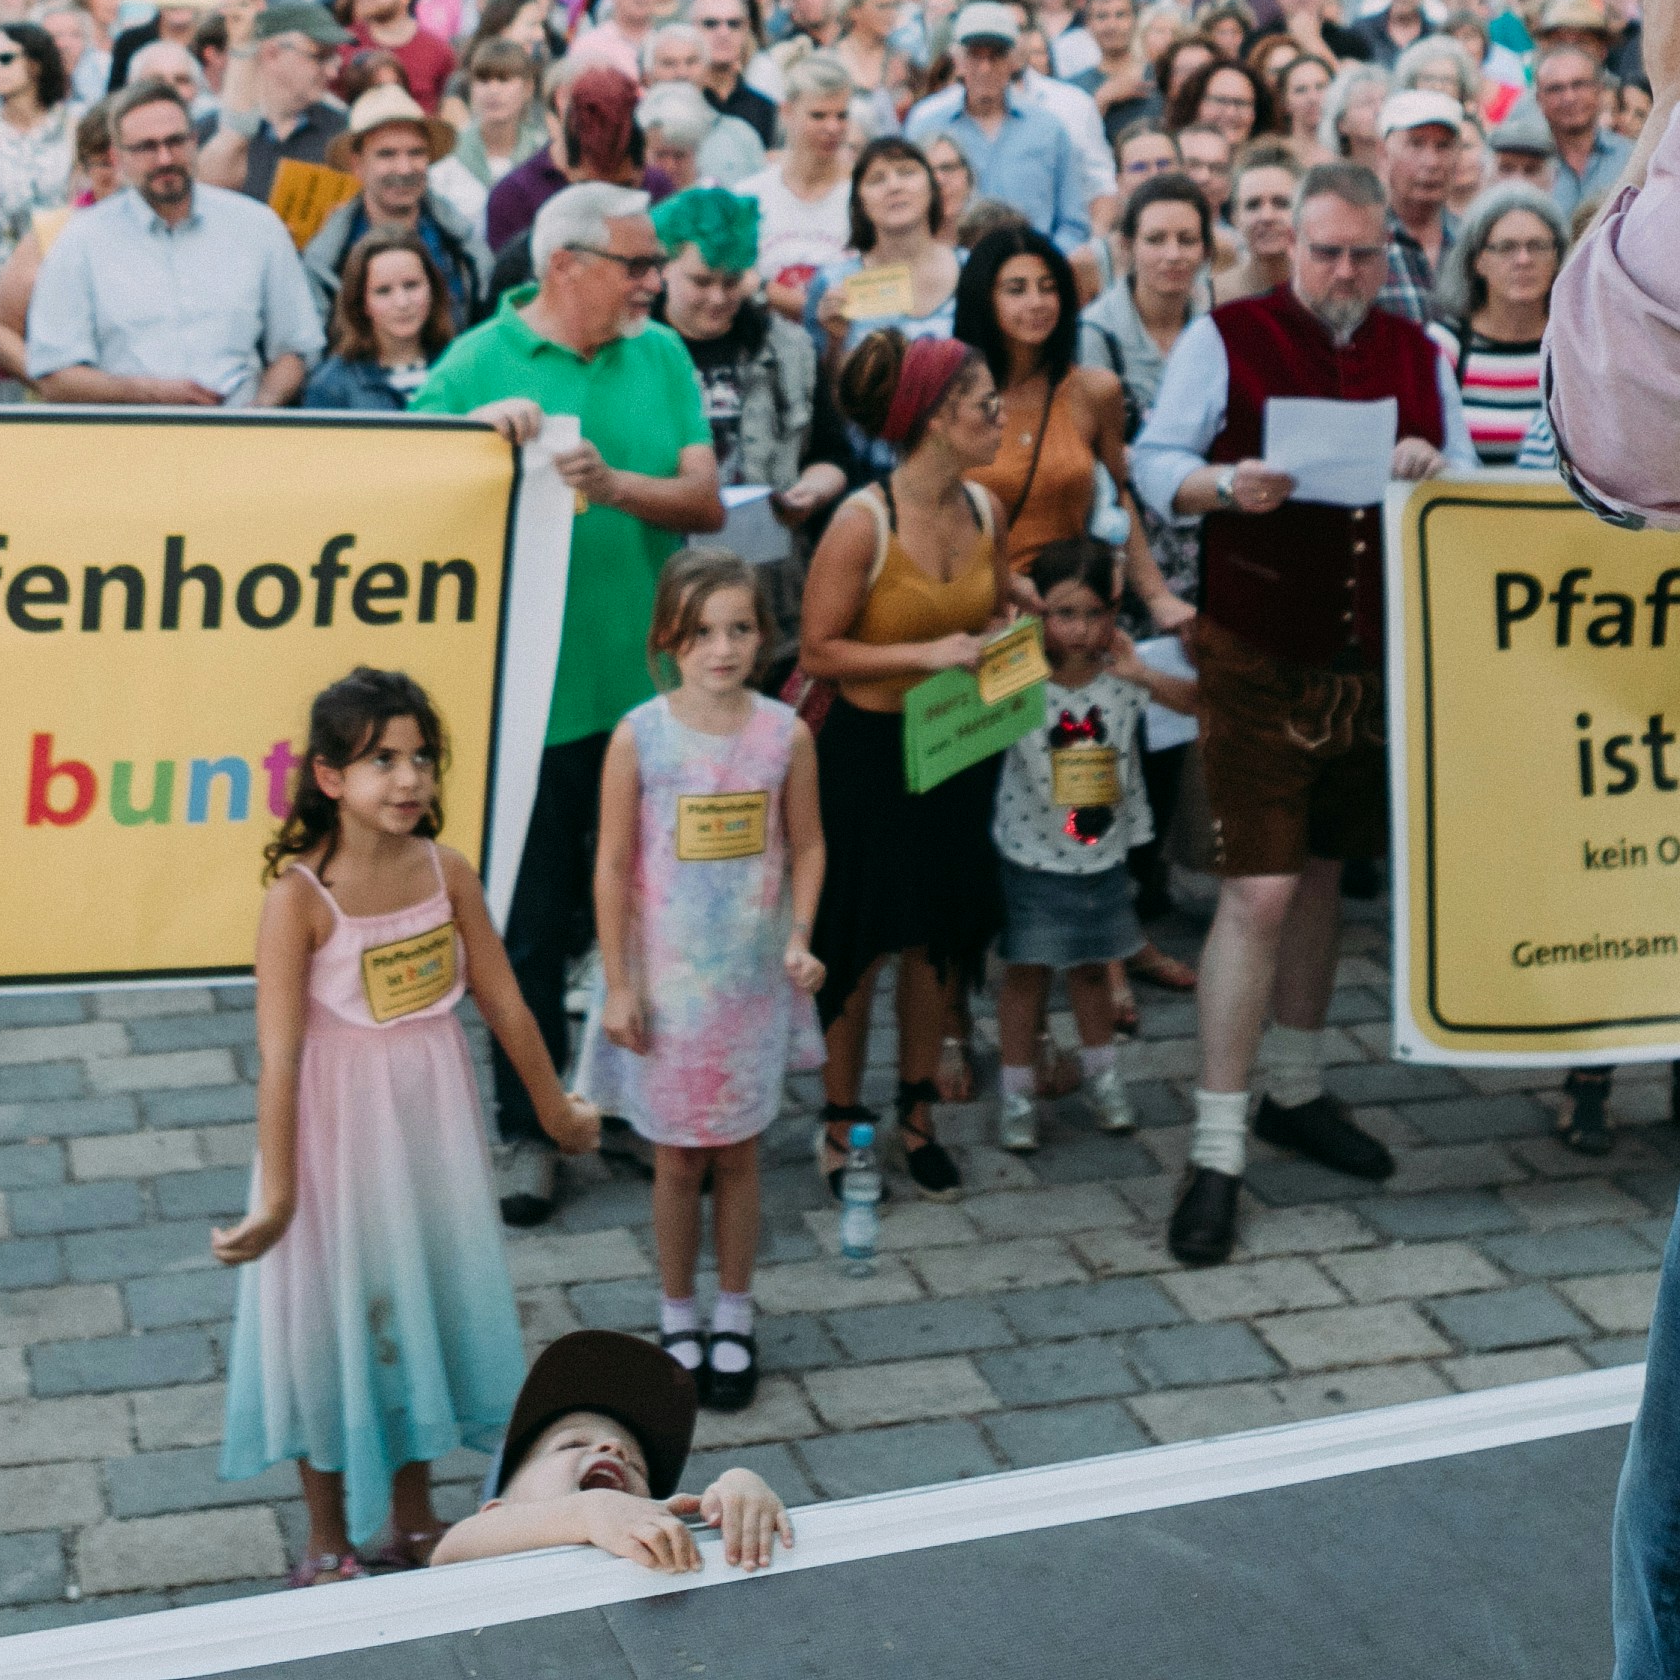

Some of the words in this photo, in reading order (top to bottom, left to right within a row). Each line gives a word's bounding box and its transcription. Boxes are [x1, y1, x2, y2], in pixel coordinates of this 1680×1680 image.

[25, 732, 300, 828] bunt
[1576, 711, 1679, 797] ist
[1583, 838, 1649, 871] kein
[1511, 930, 1680, 969] Gemeinsam
